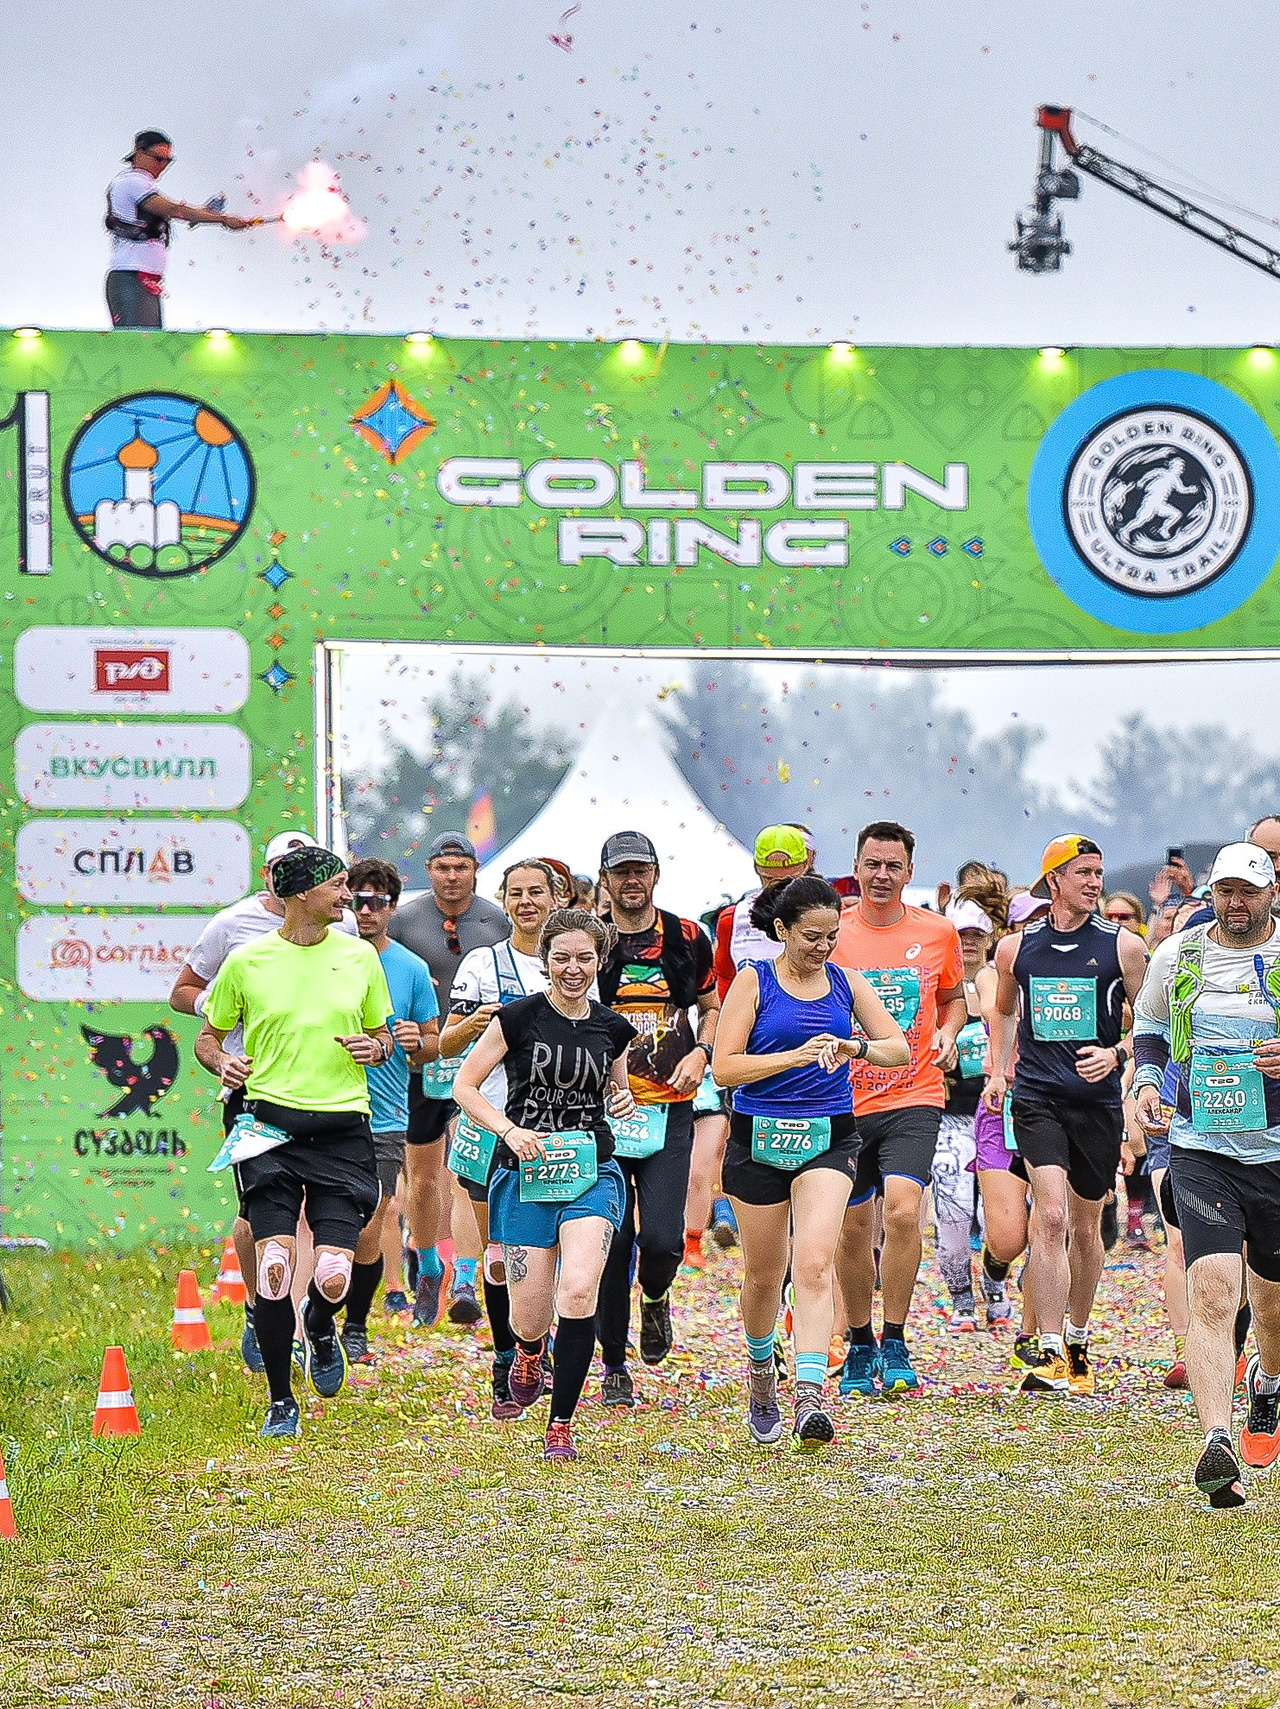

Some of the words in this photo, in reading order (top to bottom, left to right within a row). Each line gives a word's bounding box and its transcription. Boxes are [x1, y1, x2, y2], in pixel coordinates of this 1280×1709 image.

[1089, 420, 1174, 469] GOLDEN
[1181, 425, 1228, 468] RING
[436, 456, 969, 511] GOLDEN
[557, 516, 851, 567] RING
[1090, 537, 1157, 582] ULTRA
[1167, 540, 1229, 581] TRAIL
[51, 755, 217, 779] ВКУСВИЛЛ
[74, 849, 195, 875] СПЛАВ
[1043, 1006, 1082, 1021] 9068
[529, 1041, 608, 1092] RUN
[529, 1084, 565, 1105] YOUR
[566, 1090, 595, 1105] OWN
[1202, 1090, 1247, 1108] 2260
[520, 1098, 597, 1131] PACE
[612, 1120, 650, 1140] 2526
[770, 1133, 812, 1150] 2776
[538, 1162, 580, 1180] 2773
